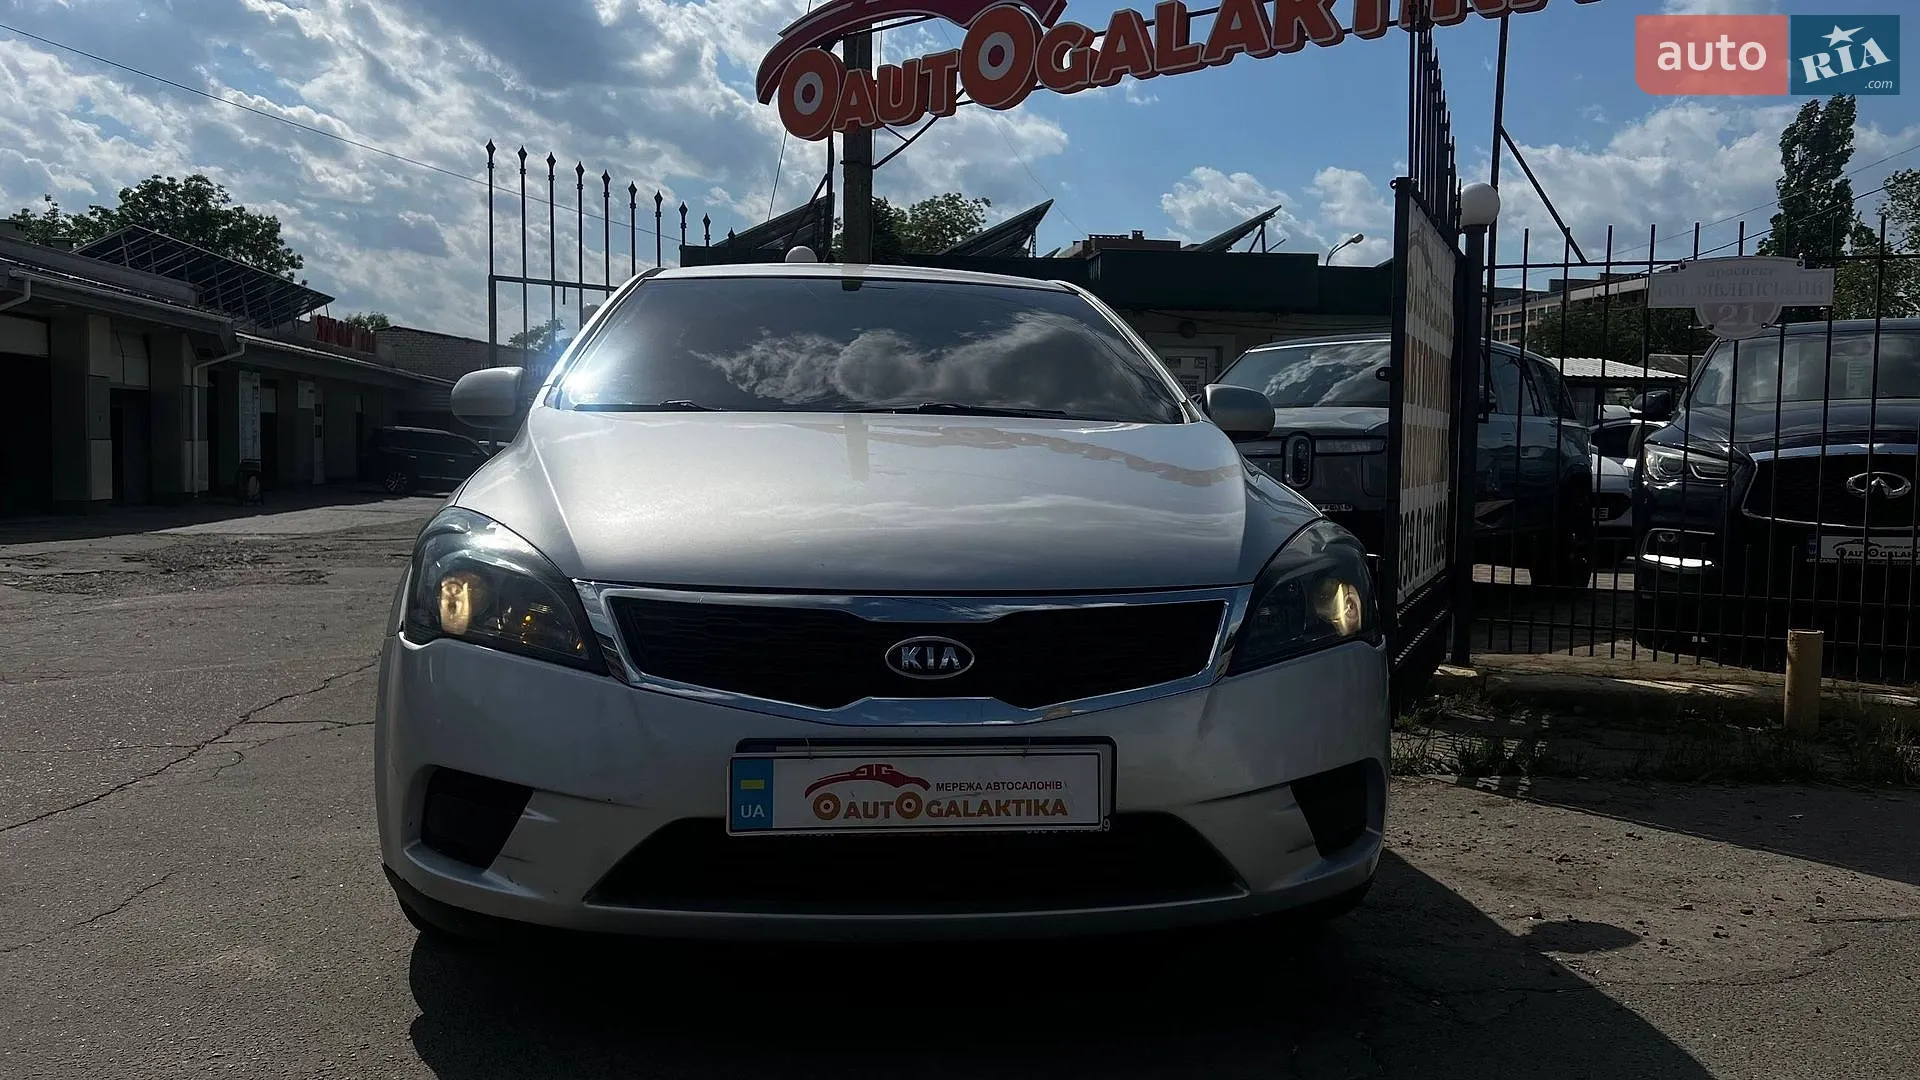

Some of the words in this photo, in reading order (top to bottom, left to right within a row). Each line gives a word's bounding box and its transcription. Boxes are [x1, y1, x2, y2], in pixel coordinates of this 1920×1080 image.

[1717, 304, 1759, 326] 21
[901, 646, 962, 670] KIA
[936, 782, 983, 792] МЕРЕЖА
[985, 780, 1063, 791] АВТОСАЛОНІВ
[740, 804, 765, 819] UA
